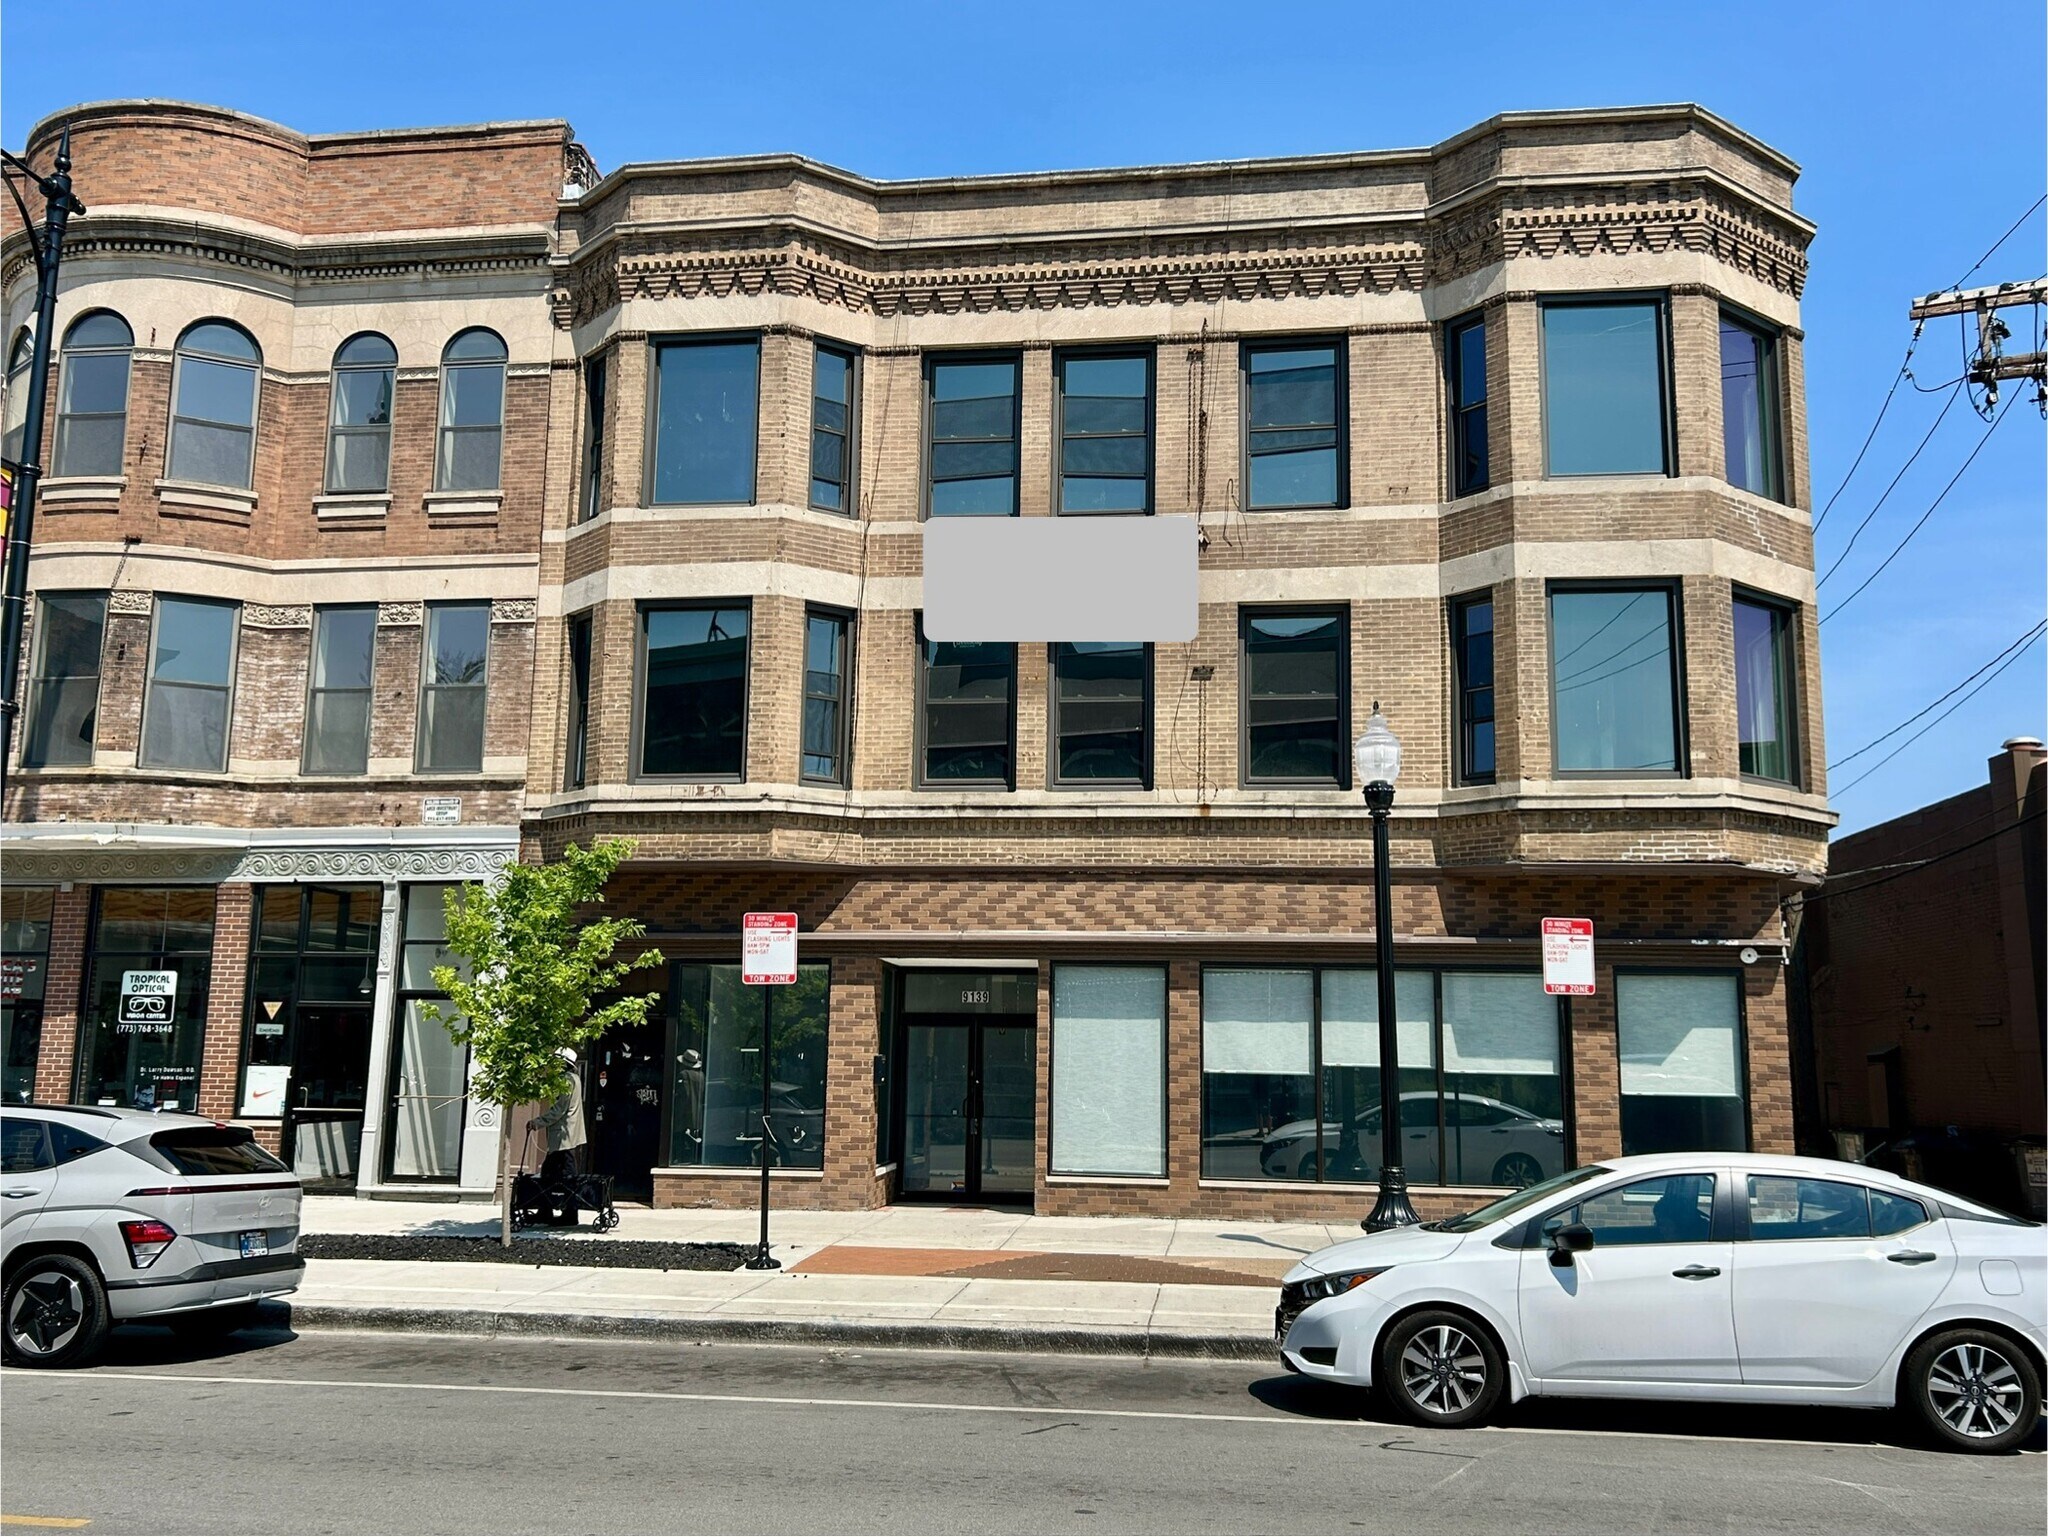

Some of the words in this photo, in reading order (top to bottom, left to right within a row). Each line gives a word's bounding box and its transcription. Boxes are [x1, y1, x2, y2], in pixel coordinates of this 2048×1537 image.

[130, 974, 171, 984] TROPICAL
[131, 984, 166, 993] OPTICAL
[1569, 985, 1590, 993] ZONE
[963, 991, 988, 1002] 9139
[116, 1024, 137, 1035] (773)
